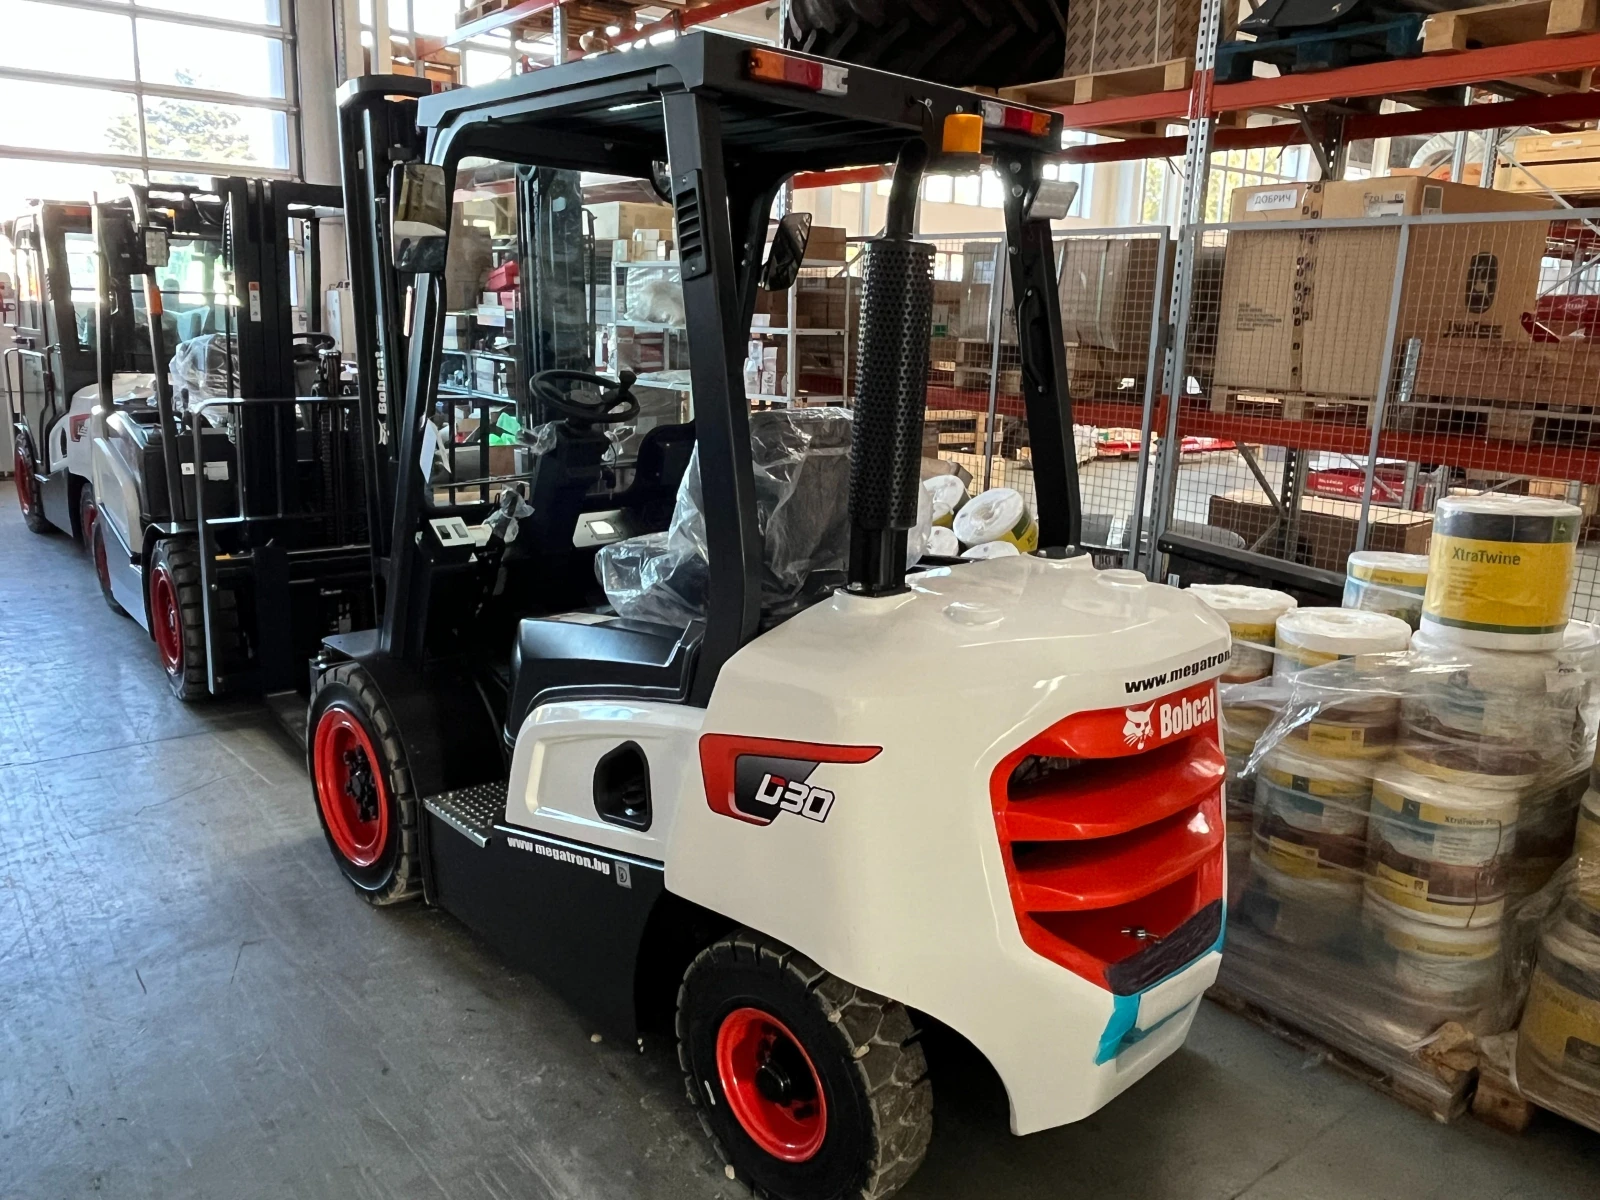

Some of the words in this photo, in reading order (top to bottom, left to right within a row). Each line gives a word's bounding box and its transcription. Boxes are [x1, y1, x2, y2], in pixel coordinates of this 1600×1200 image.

[1255, 194, 1292, 204] ДОБРИЧ
[375, 351, 387, 414] Bobcat
[1452, 547, 1521, 565] XtraTwine
[1160, 687, 1215, 739] Bobcat
[755, 773, 834, 822] D30
